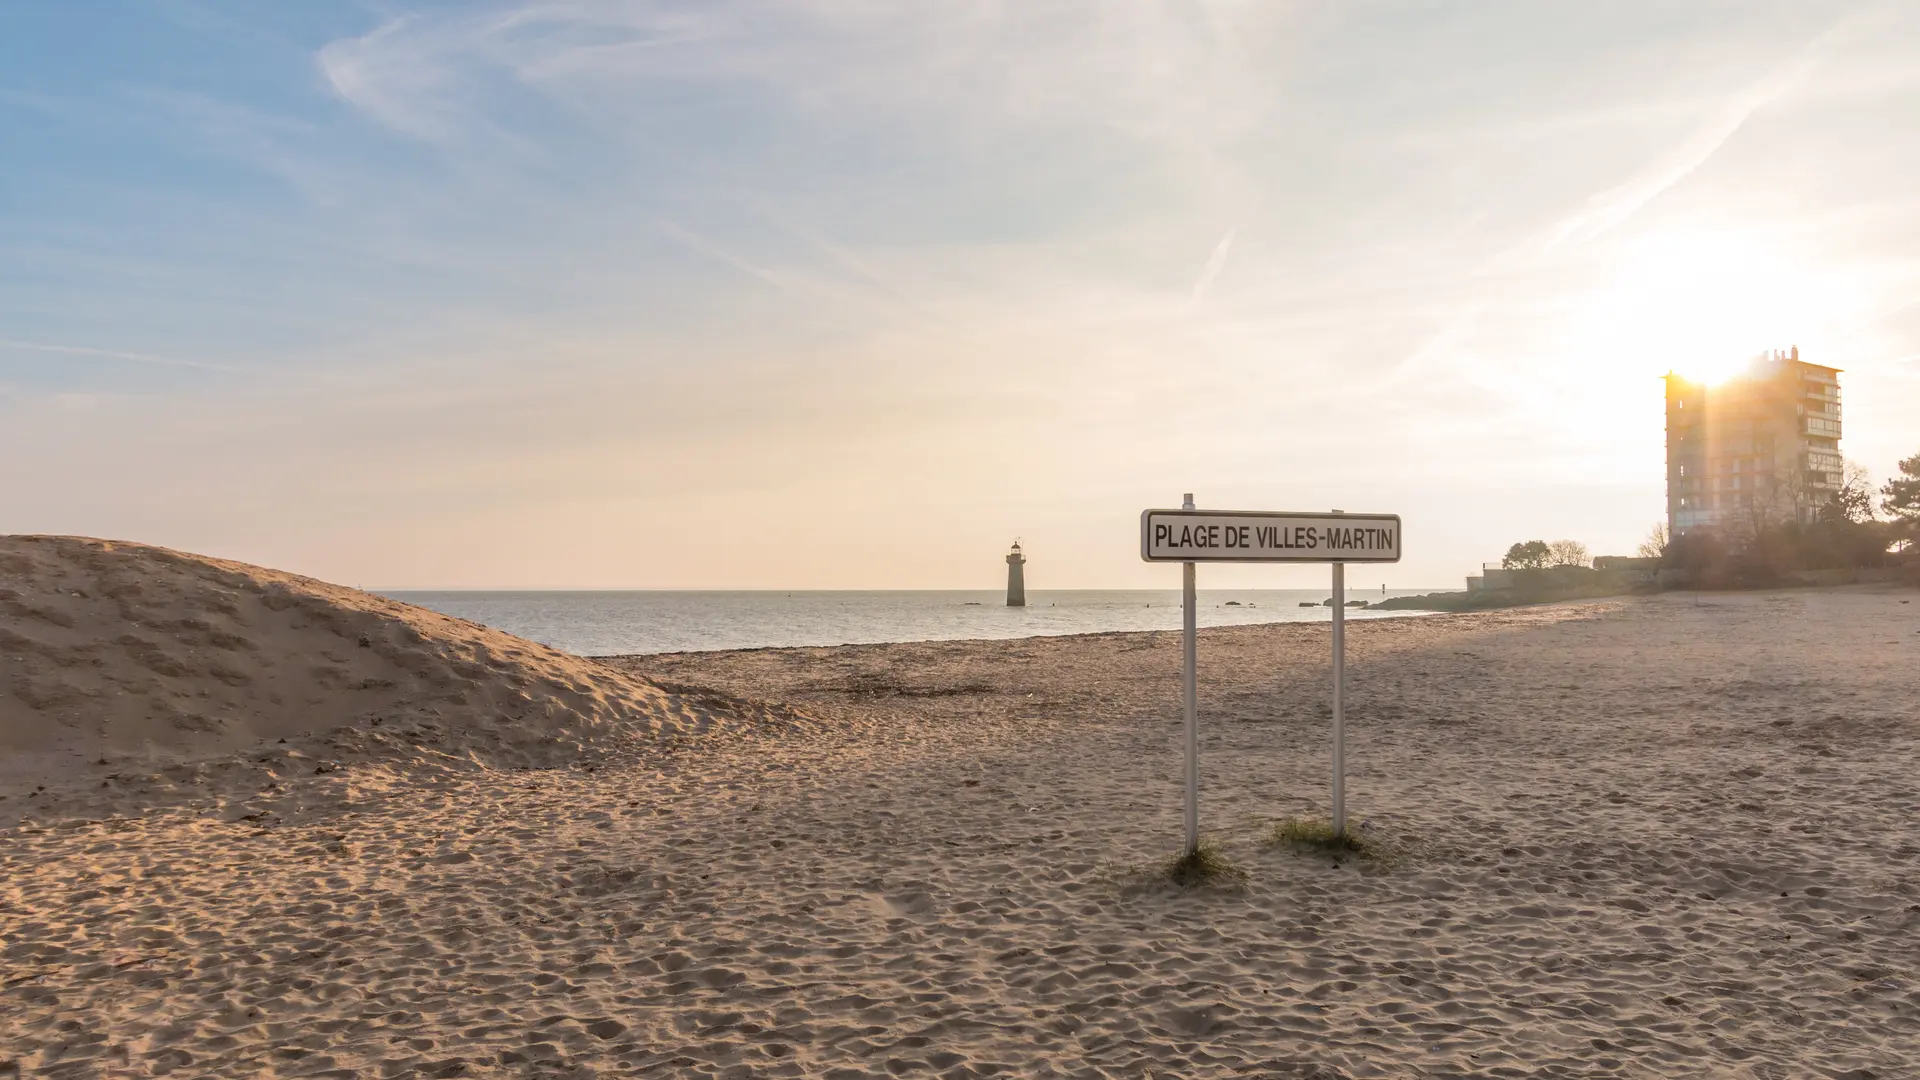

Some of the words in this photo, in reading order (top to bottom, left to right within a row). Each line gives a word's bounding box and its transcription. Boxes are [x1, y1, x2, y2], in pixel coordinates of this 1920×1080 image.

[1155, 524, 1219, 548] PLAGE
[1225, 525, 1250, 548] DE
[1256, 526, 1393, 550] VILLES-MARTIN
